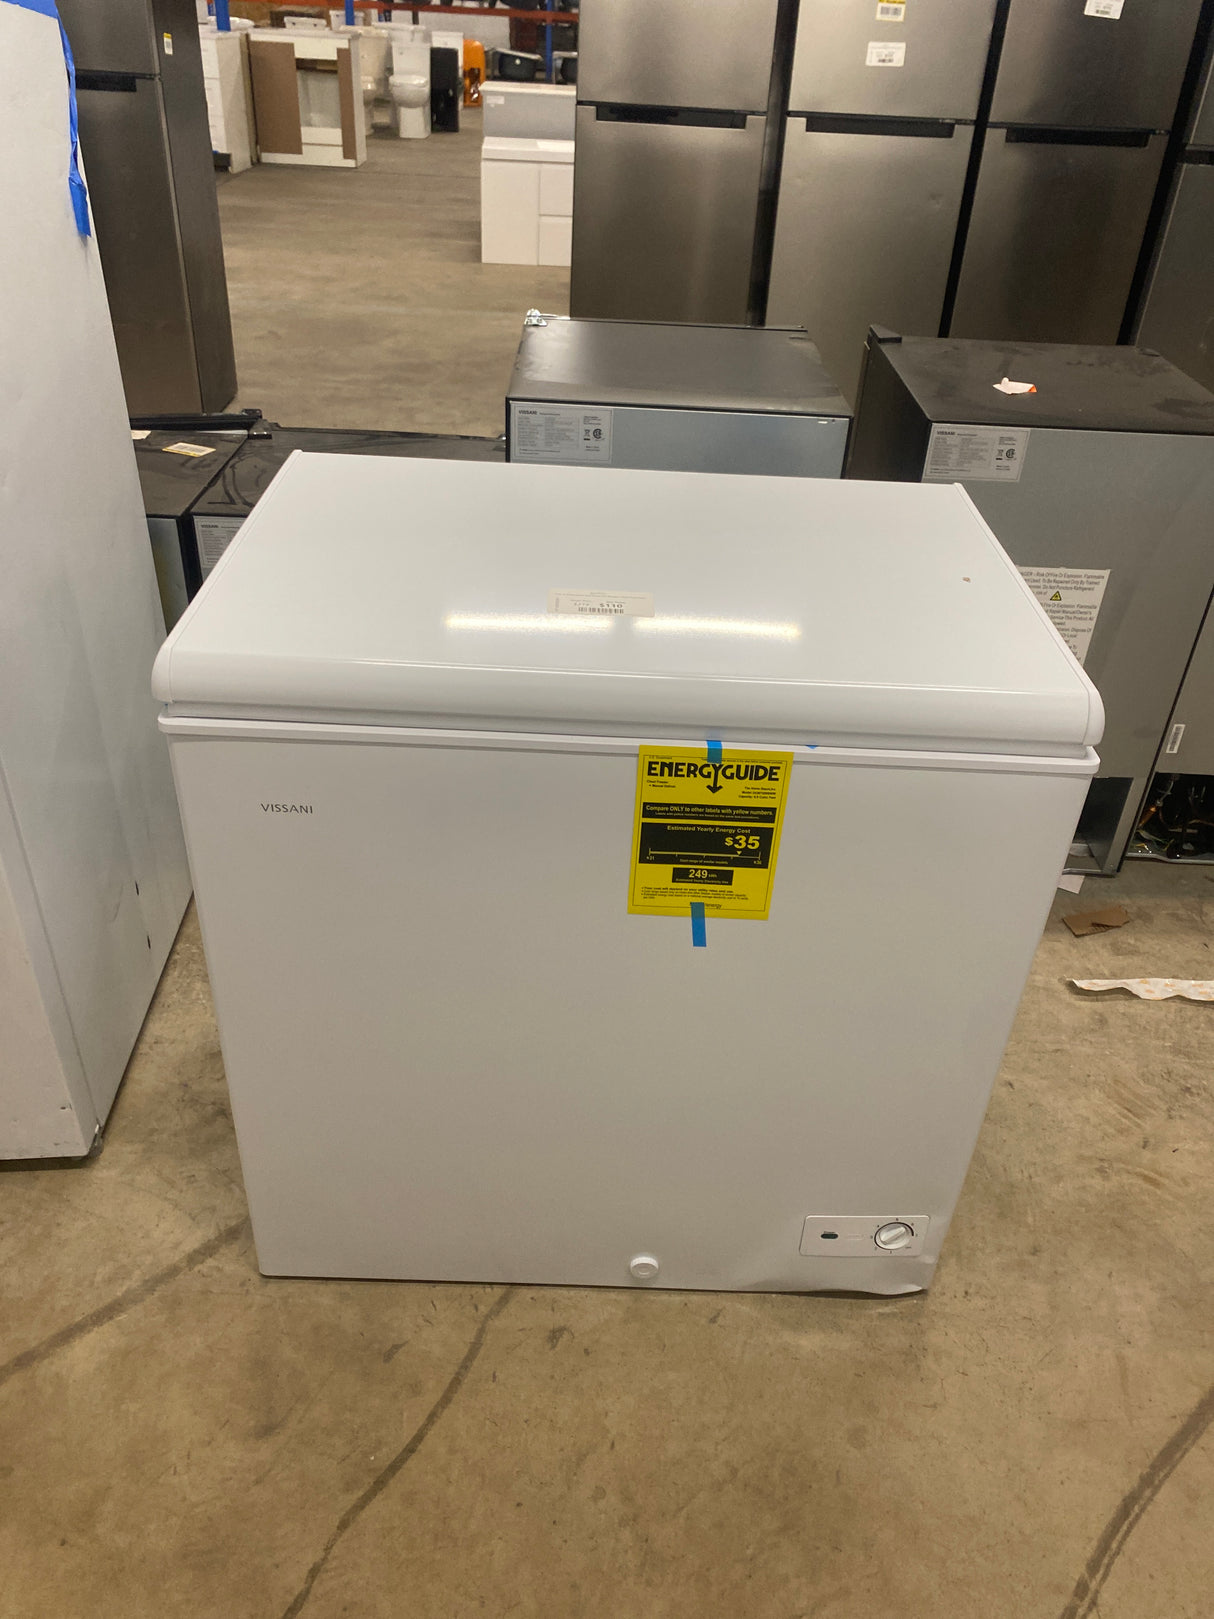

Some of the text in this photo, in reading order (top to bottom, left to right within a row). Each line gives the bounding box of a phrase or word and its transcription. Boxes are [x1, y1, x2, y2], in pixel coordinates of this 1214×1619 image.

[647, 761, 781, 781] ENERGYGUIDE
[261, 803, 313, 814] VISSANI
[725, 835, 760, 849] $35
[689, 869, 708, 878] 249
